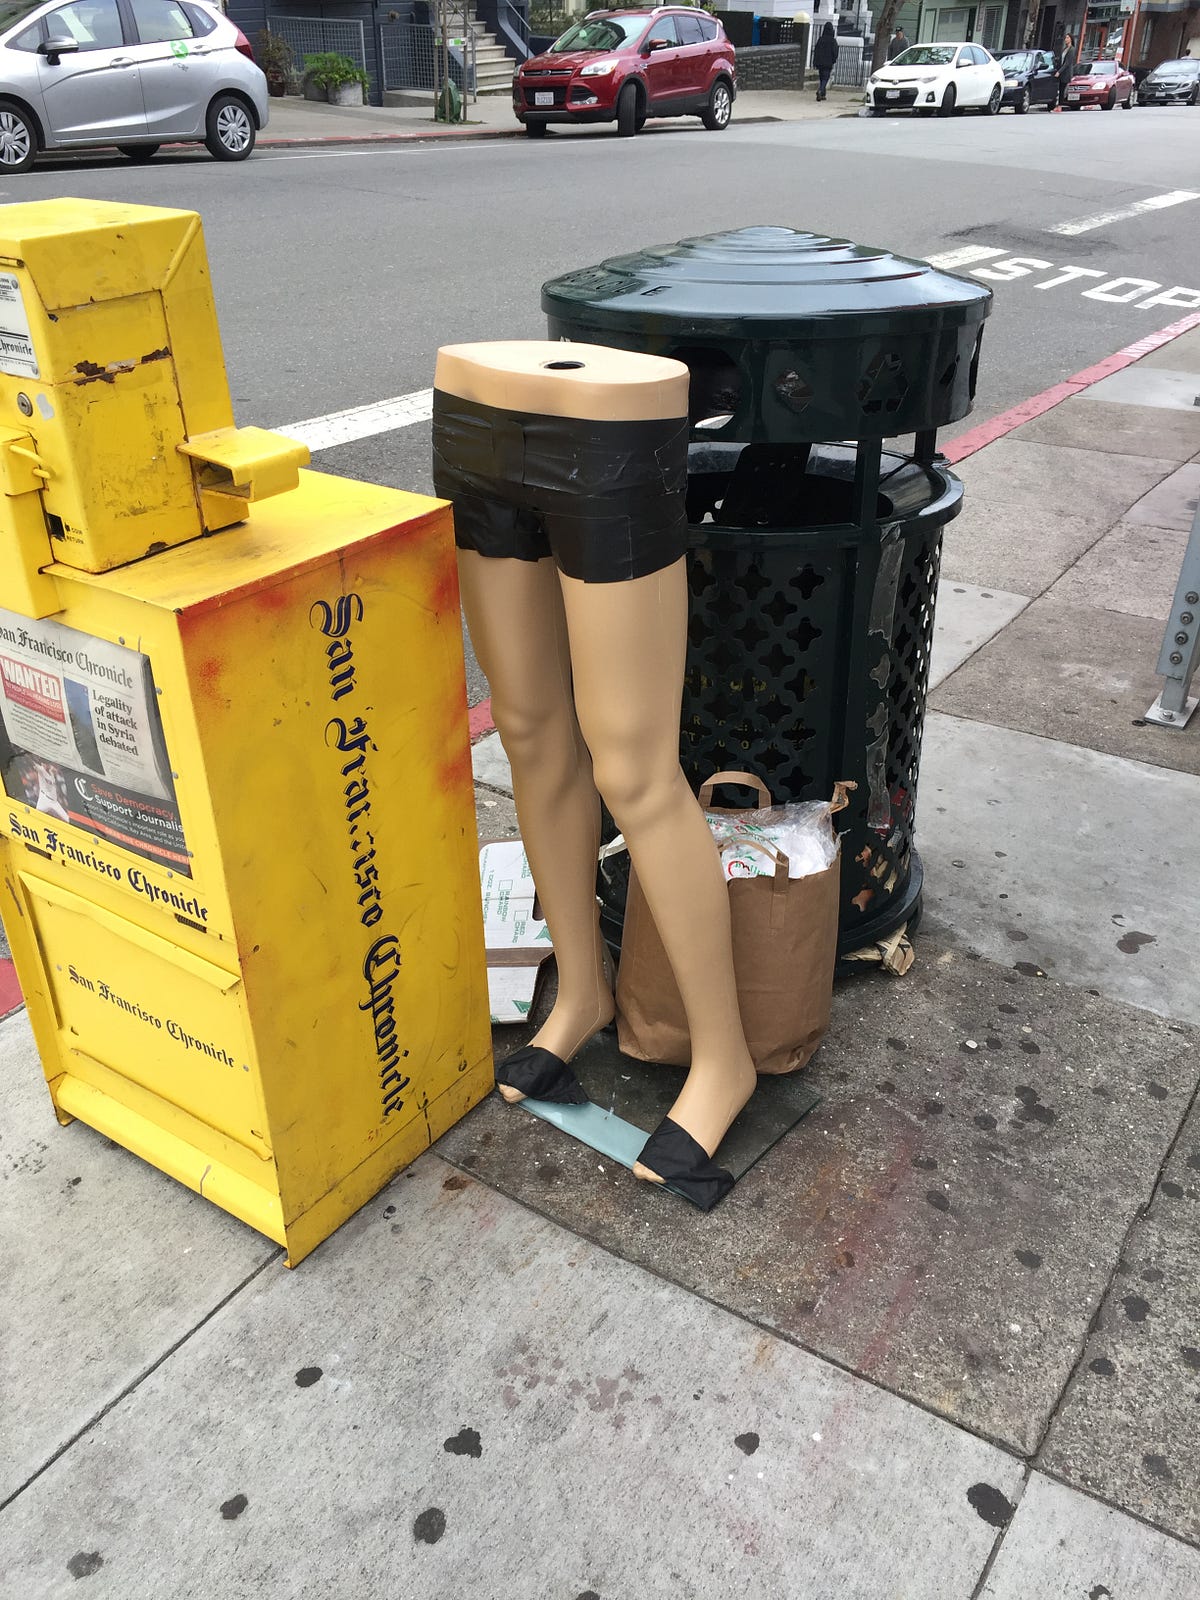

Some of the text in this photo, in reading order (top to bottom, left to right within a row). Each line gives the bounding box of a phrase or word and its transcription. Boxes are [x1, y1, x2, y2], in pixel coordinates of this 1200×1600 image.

[969, 258, 1200, 310] STOP
[17, 627, 73, 665] Francisco
[75, 650, 133, 689] Chronicle
[2, 658, 61, 701] WANTED
[93, 689, 132, 716] Legality
[95, 706, 138, 730] of attack
[97, 717, 136, 742] in Syria
[99, 733, 139, 756] debated
[90, 783, 113, 799] Save
[94, 794, 134, 818] Support
[9, 812, 40, 843] San
[43, 828, 122, 881] Francisco
[128, 867, 208, 921] Chronicle
[309, 593, 364, 702] San
[358, 933, 411, 1118] Chronicle
[512, 921, 520, 943] CHARD
[68, 965, 235, 1068] San Francisco Chronicle
